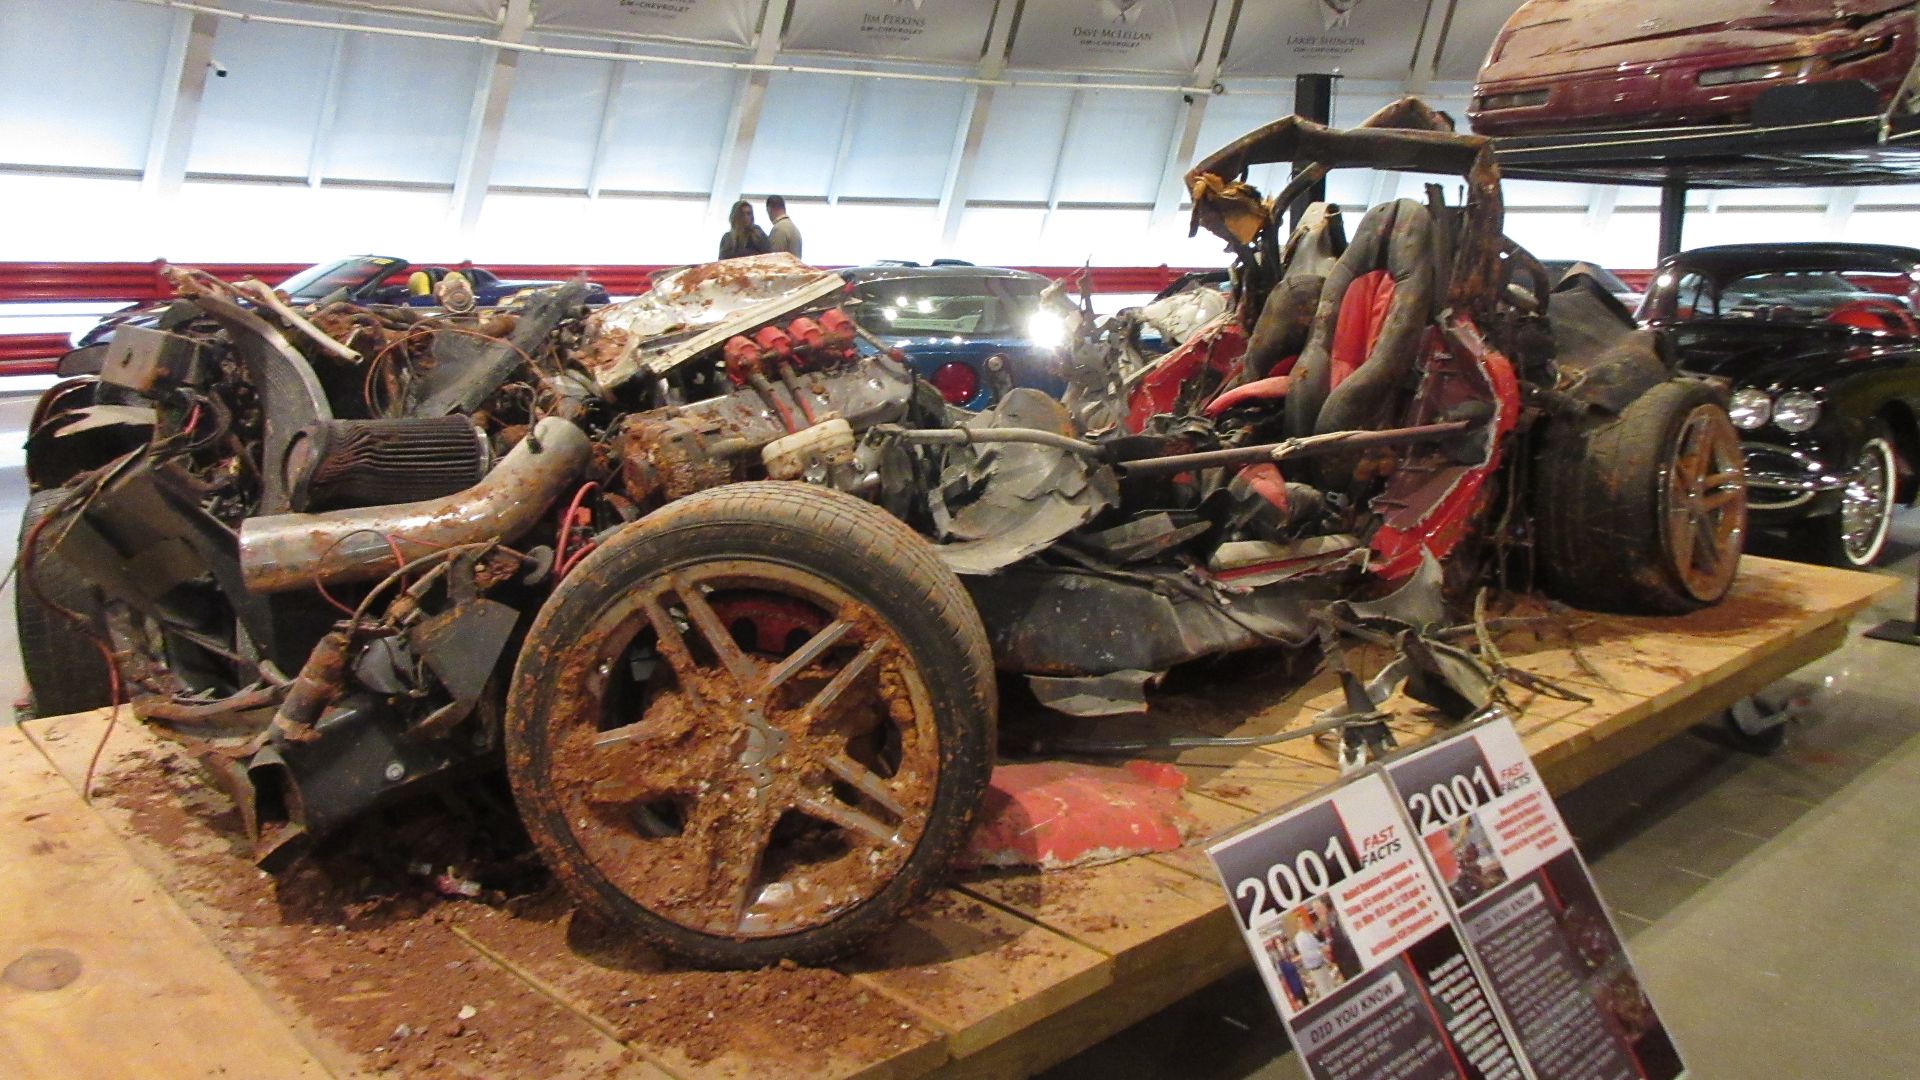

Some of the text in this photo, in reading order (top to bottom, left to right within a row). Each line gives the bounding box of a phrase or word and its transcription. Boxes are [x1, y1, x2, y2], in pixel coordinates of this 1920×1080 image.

[1409, 764, 1500, 837] 2001
[1360, 838, 1402, 867] FACTS
[1362, 824, 1396, 850] FAST
[1236, 835, 1355, 930] 2001
[1309, 1021, 1334, 1045] DID
[1336, 1003, 1360, 1028] YOU
